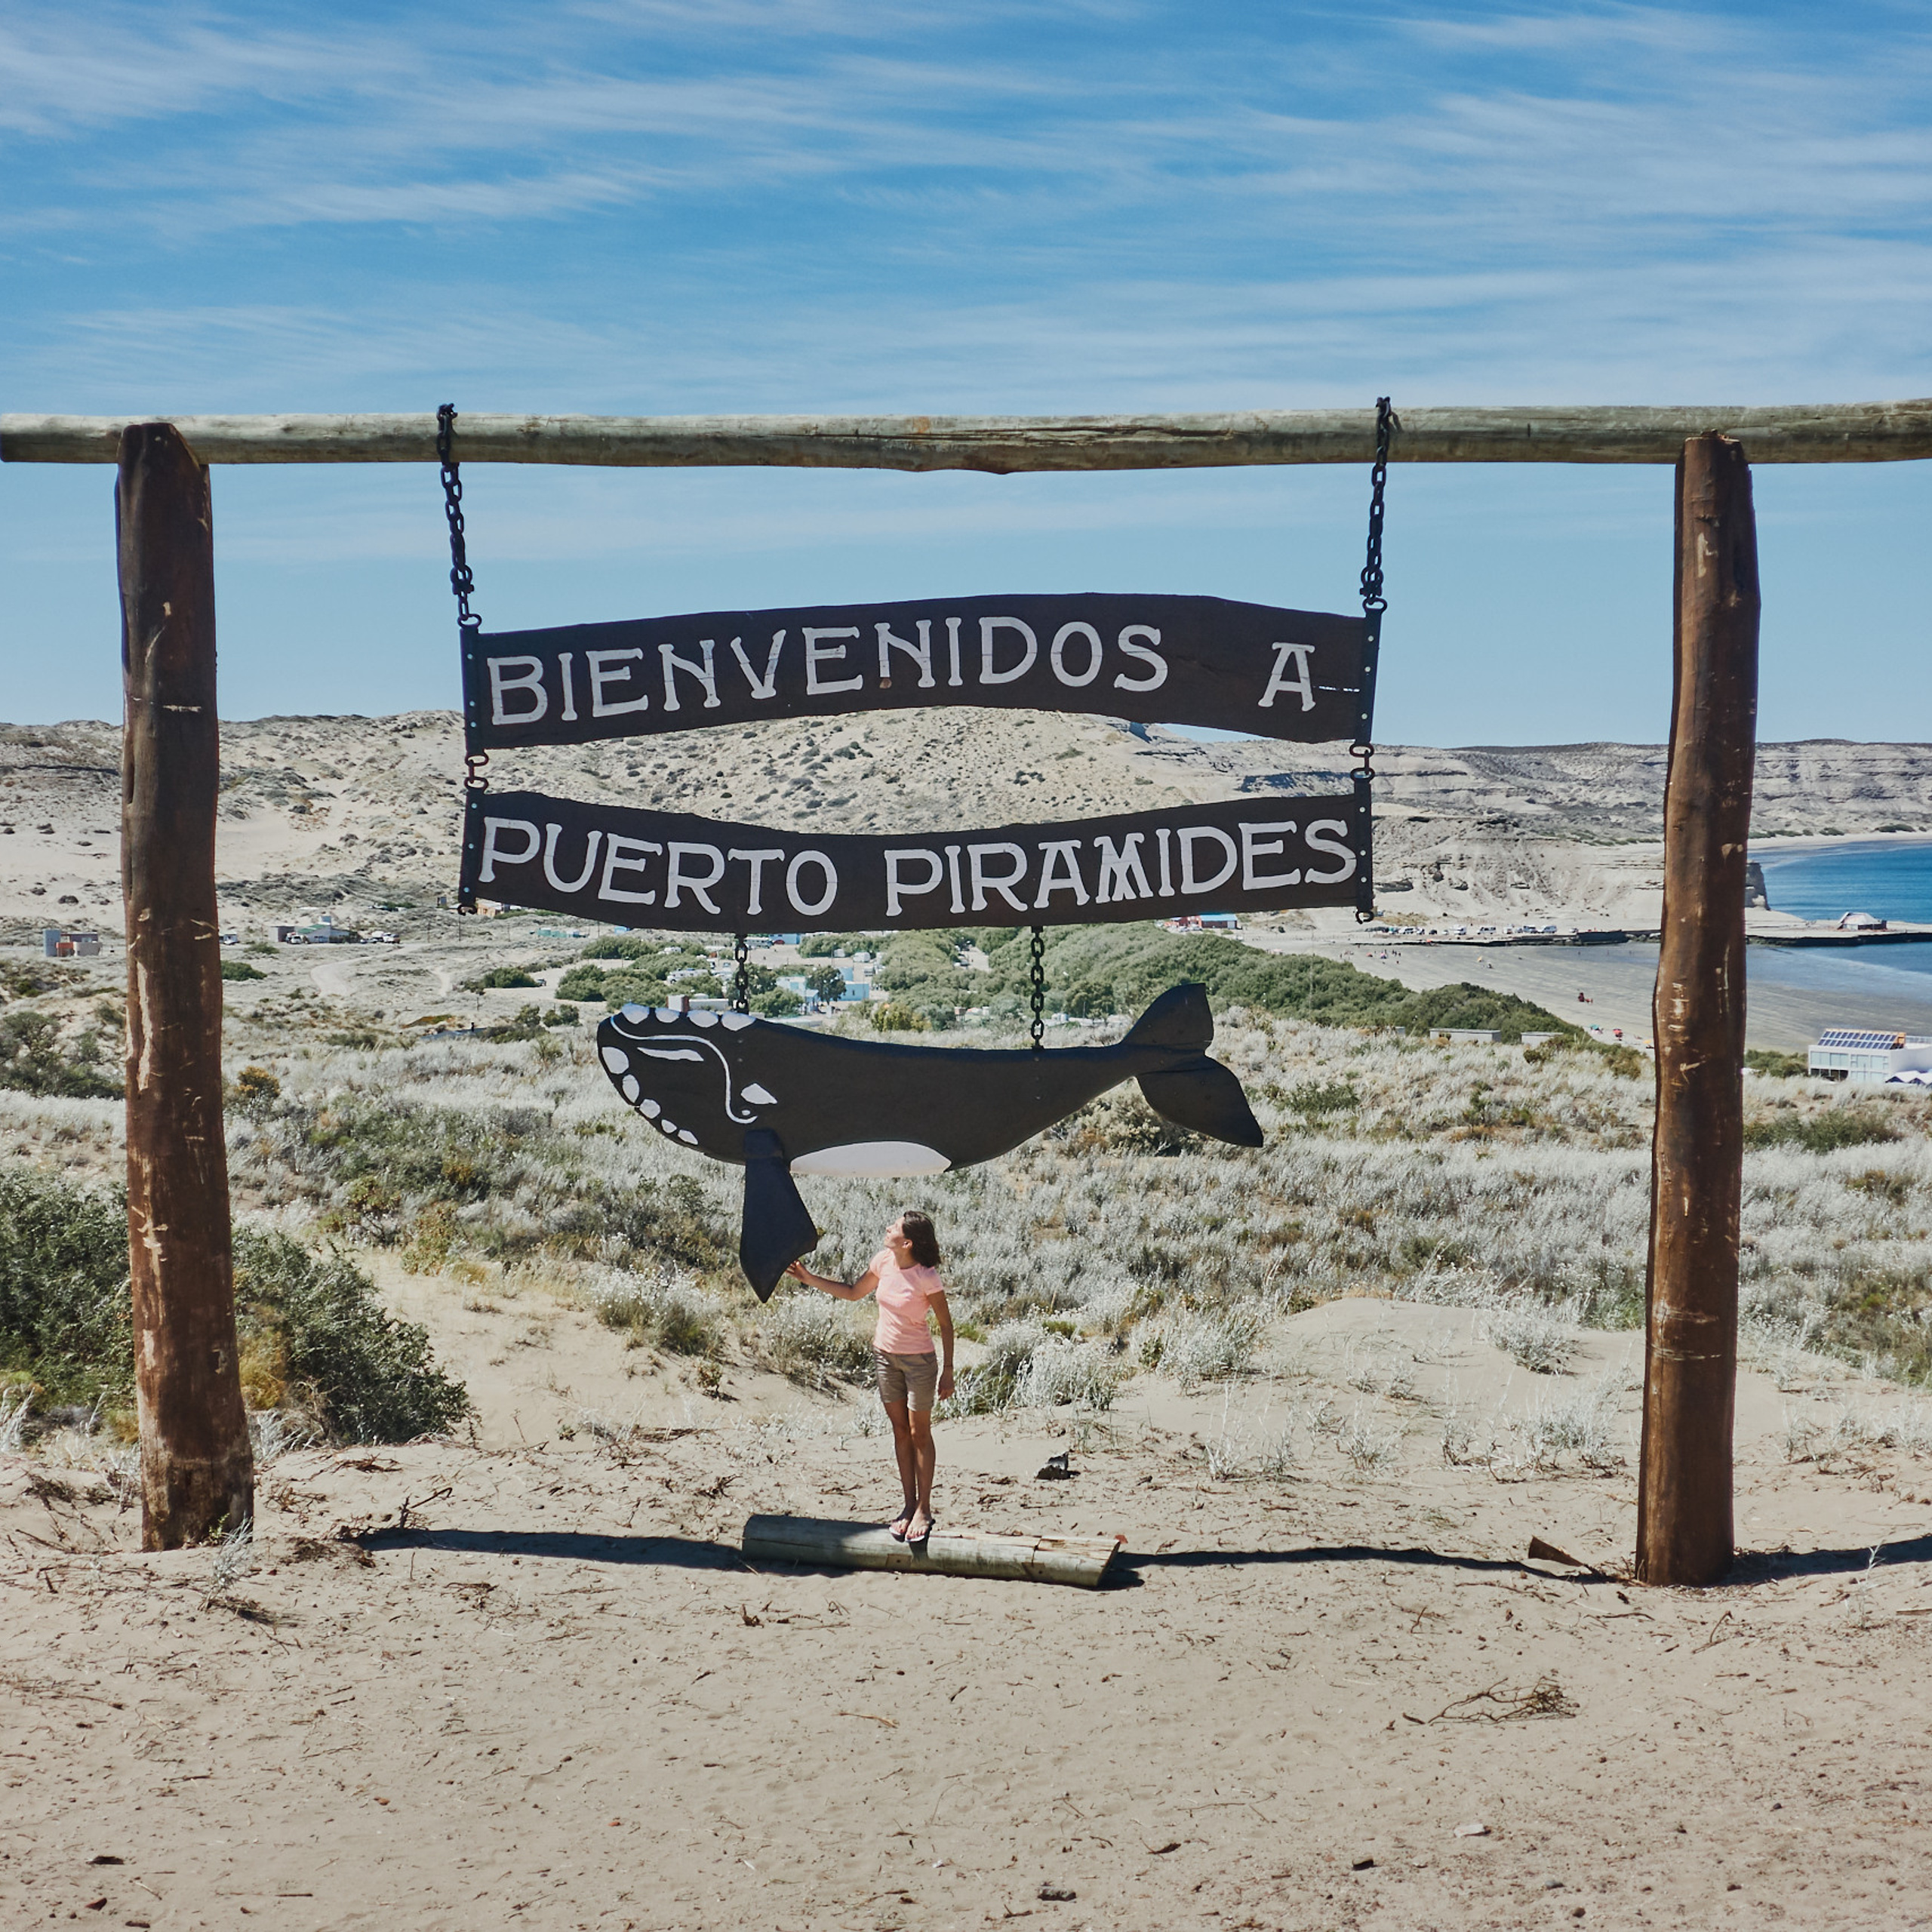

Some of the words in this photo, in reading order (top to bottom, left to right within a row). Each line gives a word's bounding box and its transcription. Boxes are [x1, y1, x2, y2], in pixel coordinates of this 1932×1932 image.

[487, 617, 1168, 725] BIENVENIDOS
[1257, 641, 1316, 712] A
[478, 816, 838, 916] PUERTO
[884, 819, 1357, 917] PIRAMIDES
